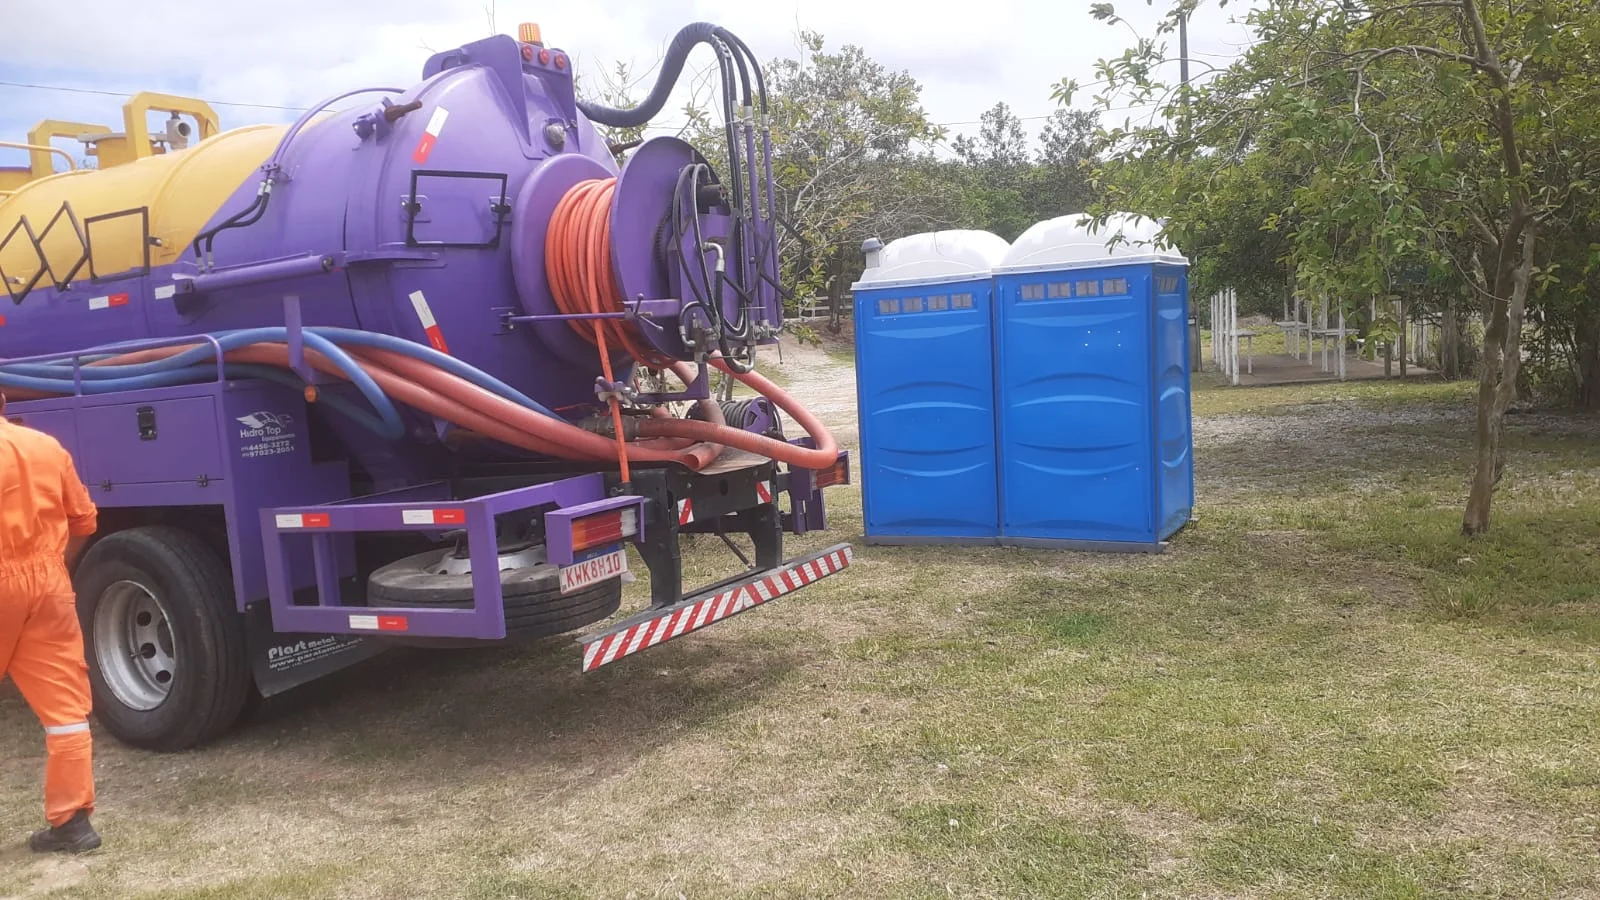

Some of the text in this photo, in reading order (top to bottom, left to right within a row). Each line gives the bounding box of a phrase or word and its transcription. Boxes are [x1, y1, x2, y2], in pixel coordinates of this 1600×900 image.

[240, 428, 264, 438] Hidro
[265, 426, 281, 436] Top
[566, 553, 621, 588] KWK8H10
[268, 640, 306, 659] Plast
